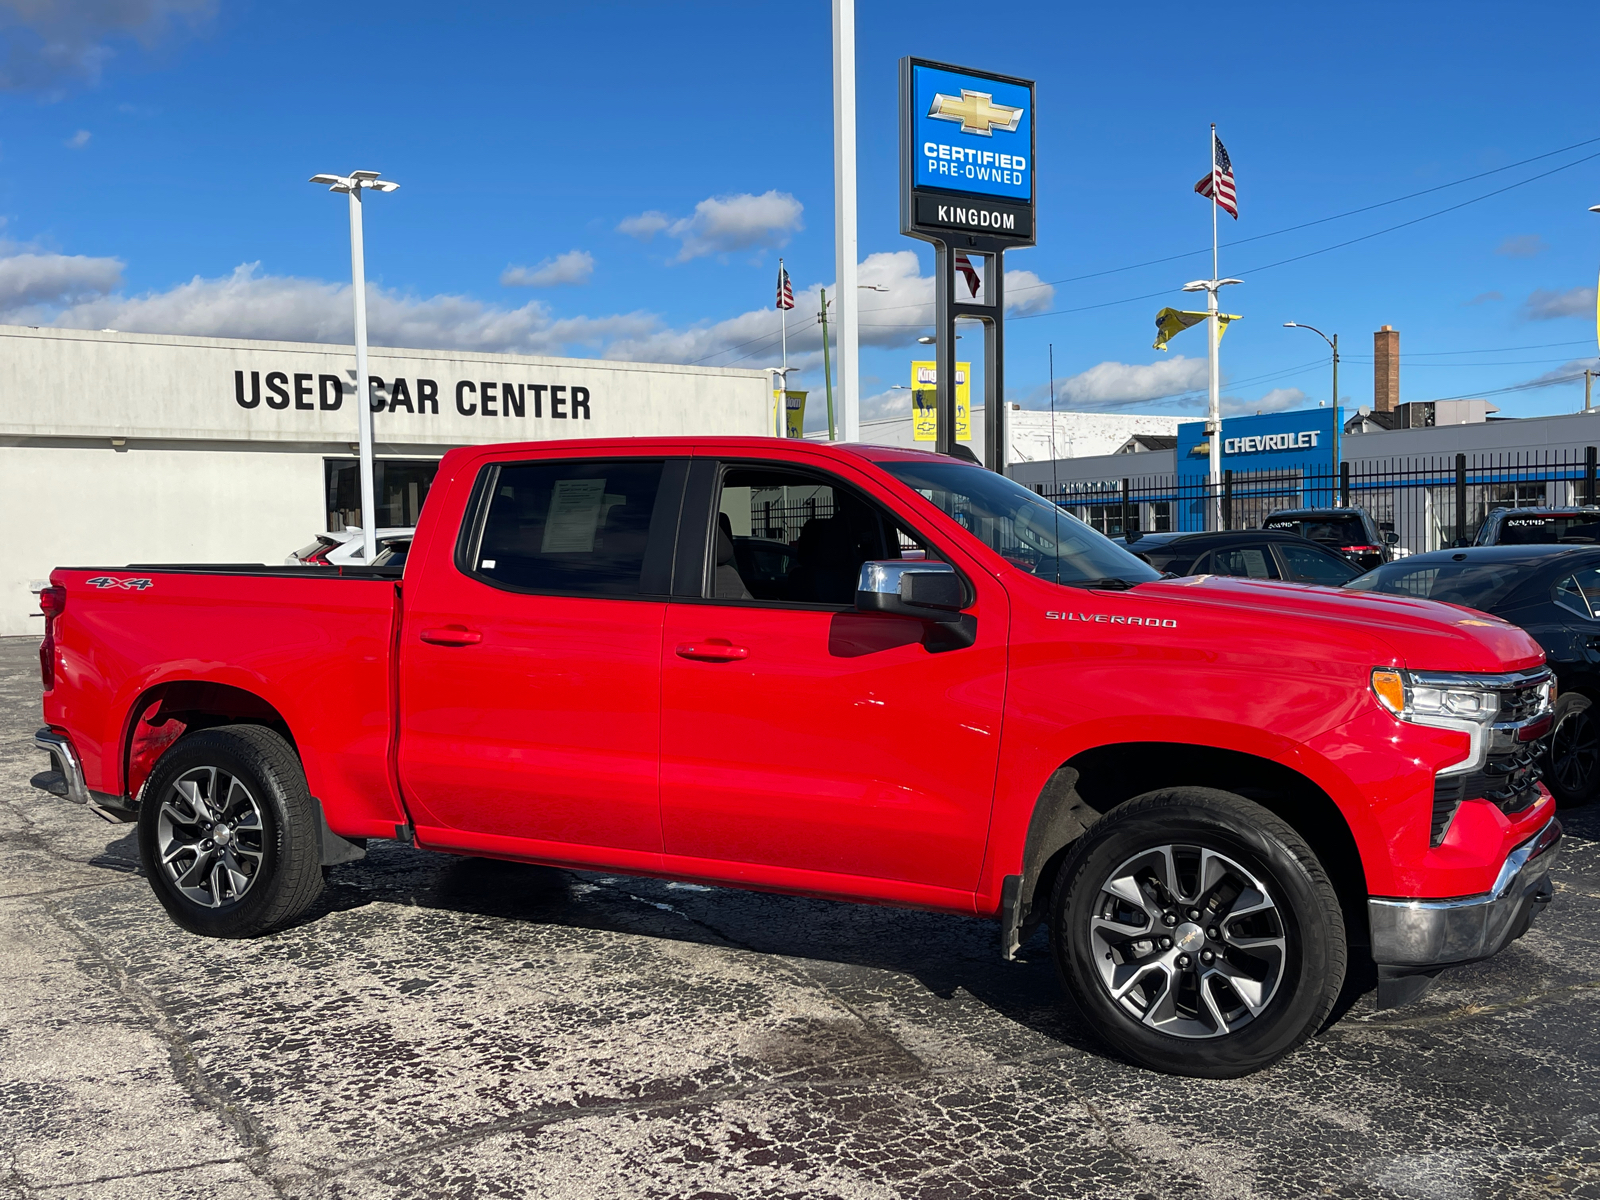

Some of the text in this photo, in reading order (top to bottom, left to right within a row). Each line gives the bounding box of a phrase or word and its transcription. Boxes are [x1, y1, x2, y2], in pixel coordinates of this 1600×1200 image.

[924, 142, 1026, 170] CERTIFIED
[928, 159, 1022, 185] PRE-OWNED
[938, 205, 1014, 230] KINGDOM
[234, 370, 591, 420] USED CAR CENTER
[1225, 430, 1320, 454] CHEVROLET
[1045, 611, 1177, 628] SILVERADO
